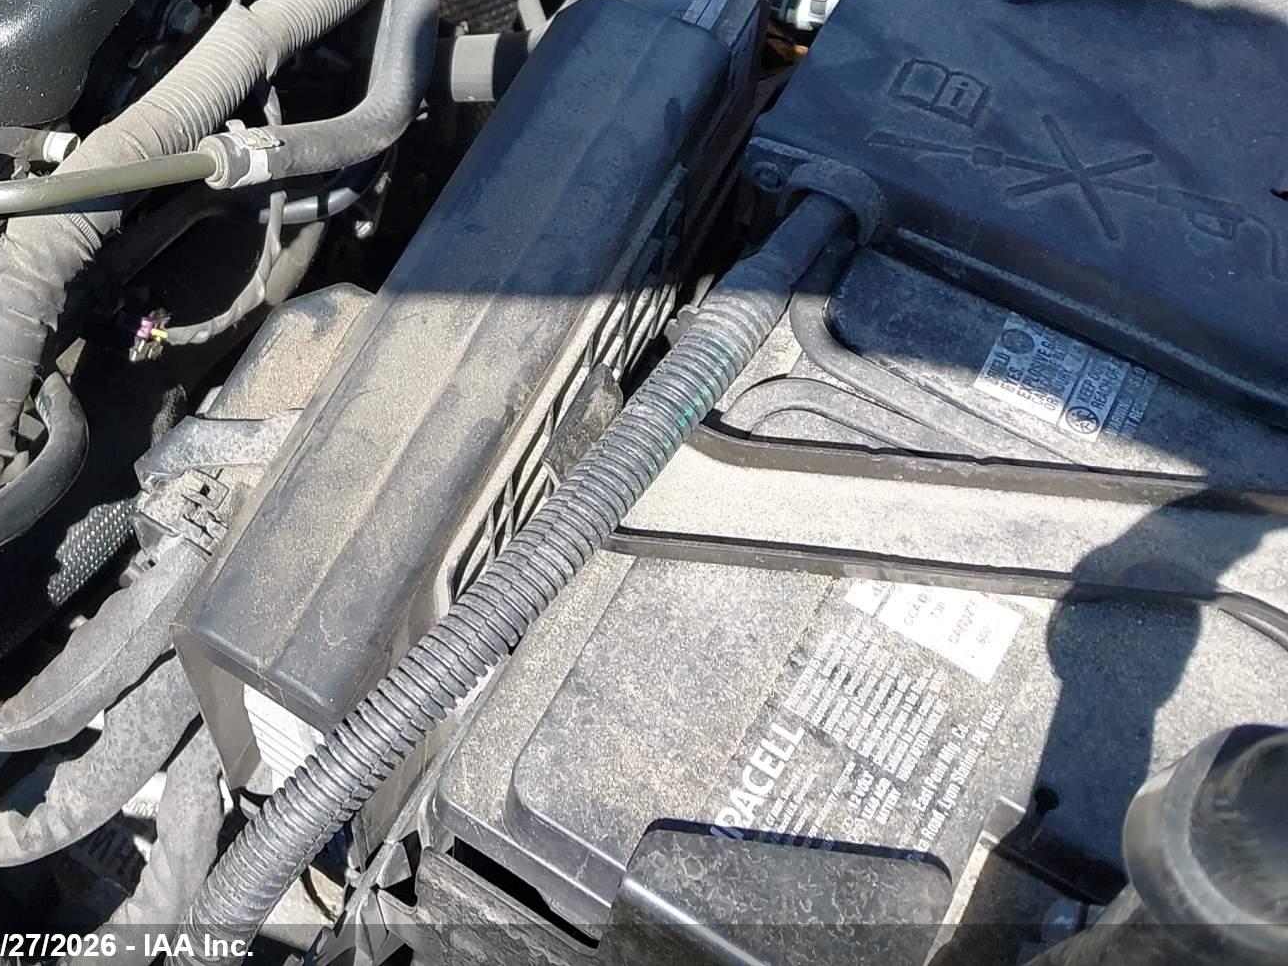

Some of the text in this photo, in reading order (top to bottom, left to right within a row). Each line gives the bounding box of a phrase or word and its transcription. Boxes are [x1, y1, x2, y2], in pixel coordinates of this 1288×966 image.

[969, 727, 989, 745] PA
[948, 742, 983, 786] Station,
[851, 768, 876, 797] VOLT
[911, 785, 934, 811] East
[923, 760, 948, 789] Penn
[935, 780, 963, 810] Lyon
[874, 785, 903, 824] BATTERY
[919, 806, 949, 840] Road,
